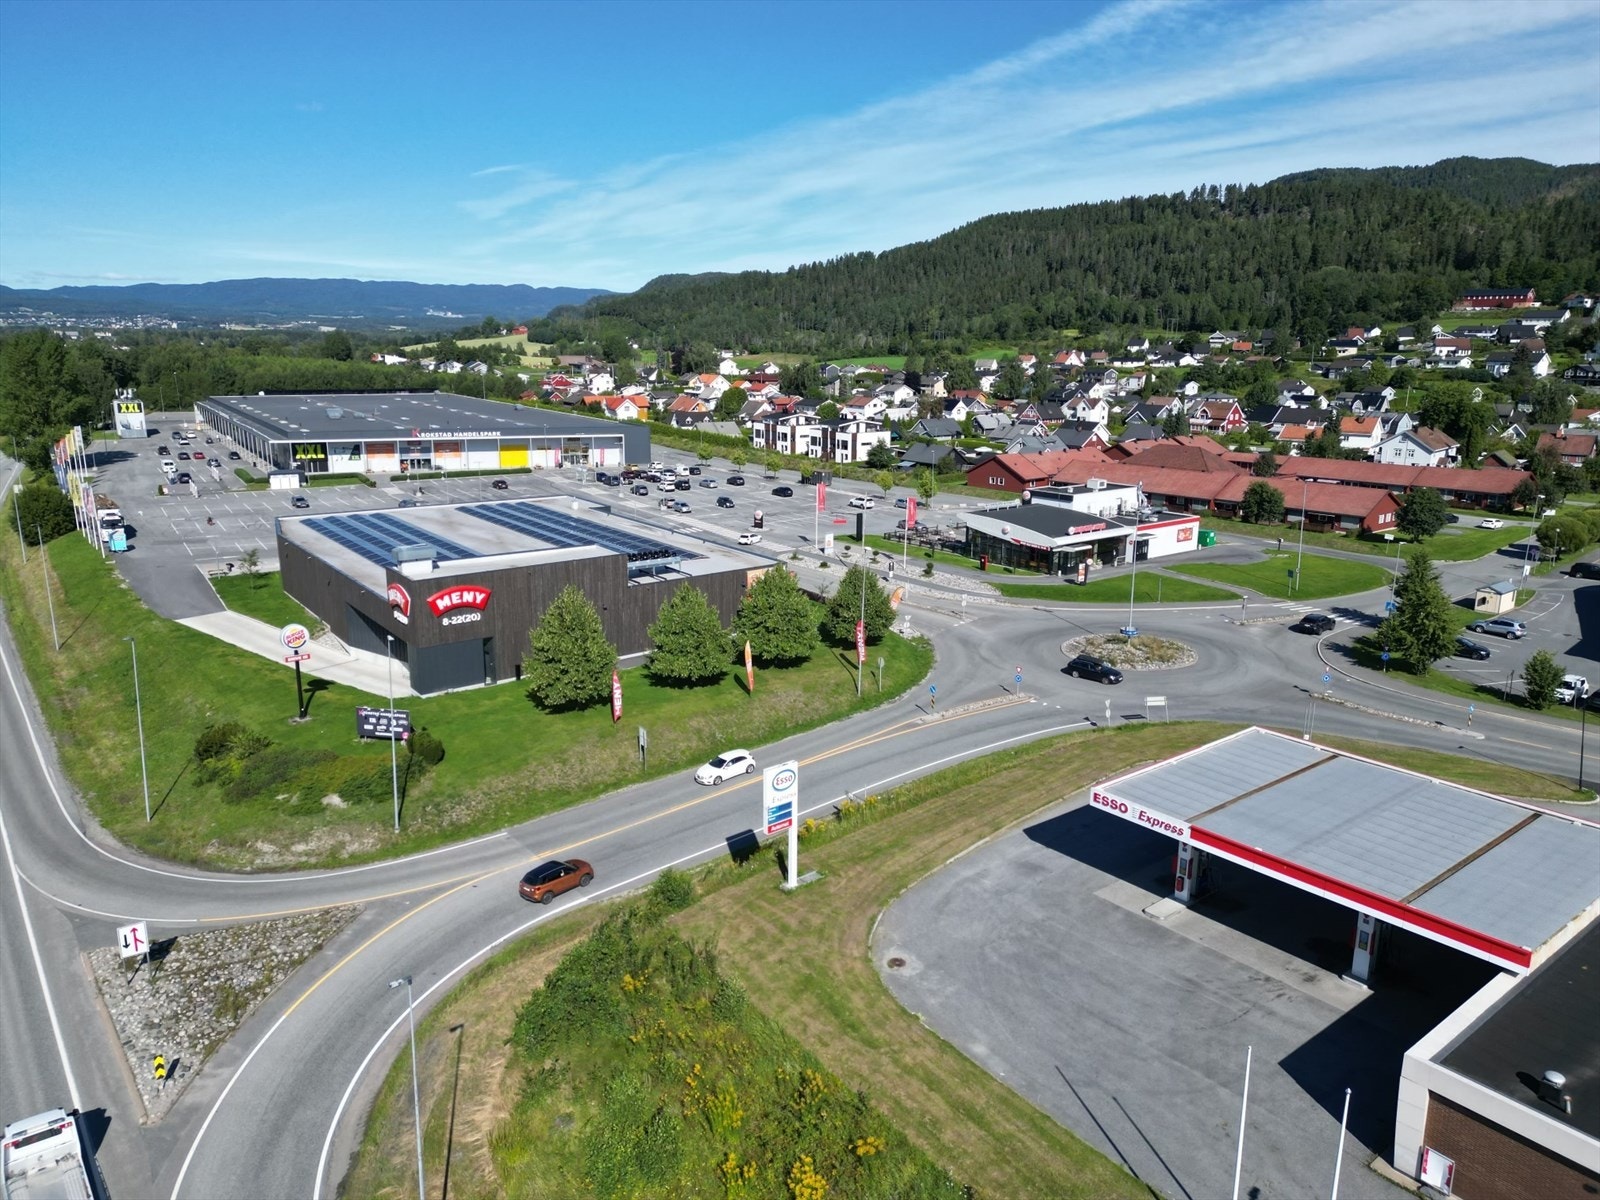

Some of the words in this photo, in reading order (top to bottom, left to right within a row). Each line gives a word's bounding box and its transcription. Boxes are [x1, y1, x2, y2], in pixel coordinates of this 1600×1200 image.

[120, 403, 140, 413] XXL
[412, 428, 452, 438] KROKSTAD
[295, 444, 325, 459] XXL
[435, 590, 486, 610] MENY
[442, 612, 481, 626] 8-22(20)
[286, 629, 304, 640] BURGER
[287, 633, 306, 645] KING
[612, 681, 622, 716] MENY
[1093, 792, 1129, 814] ESSO
[1137, 810, 1185, 836] Express
